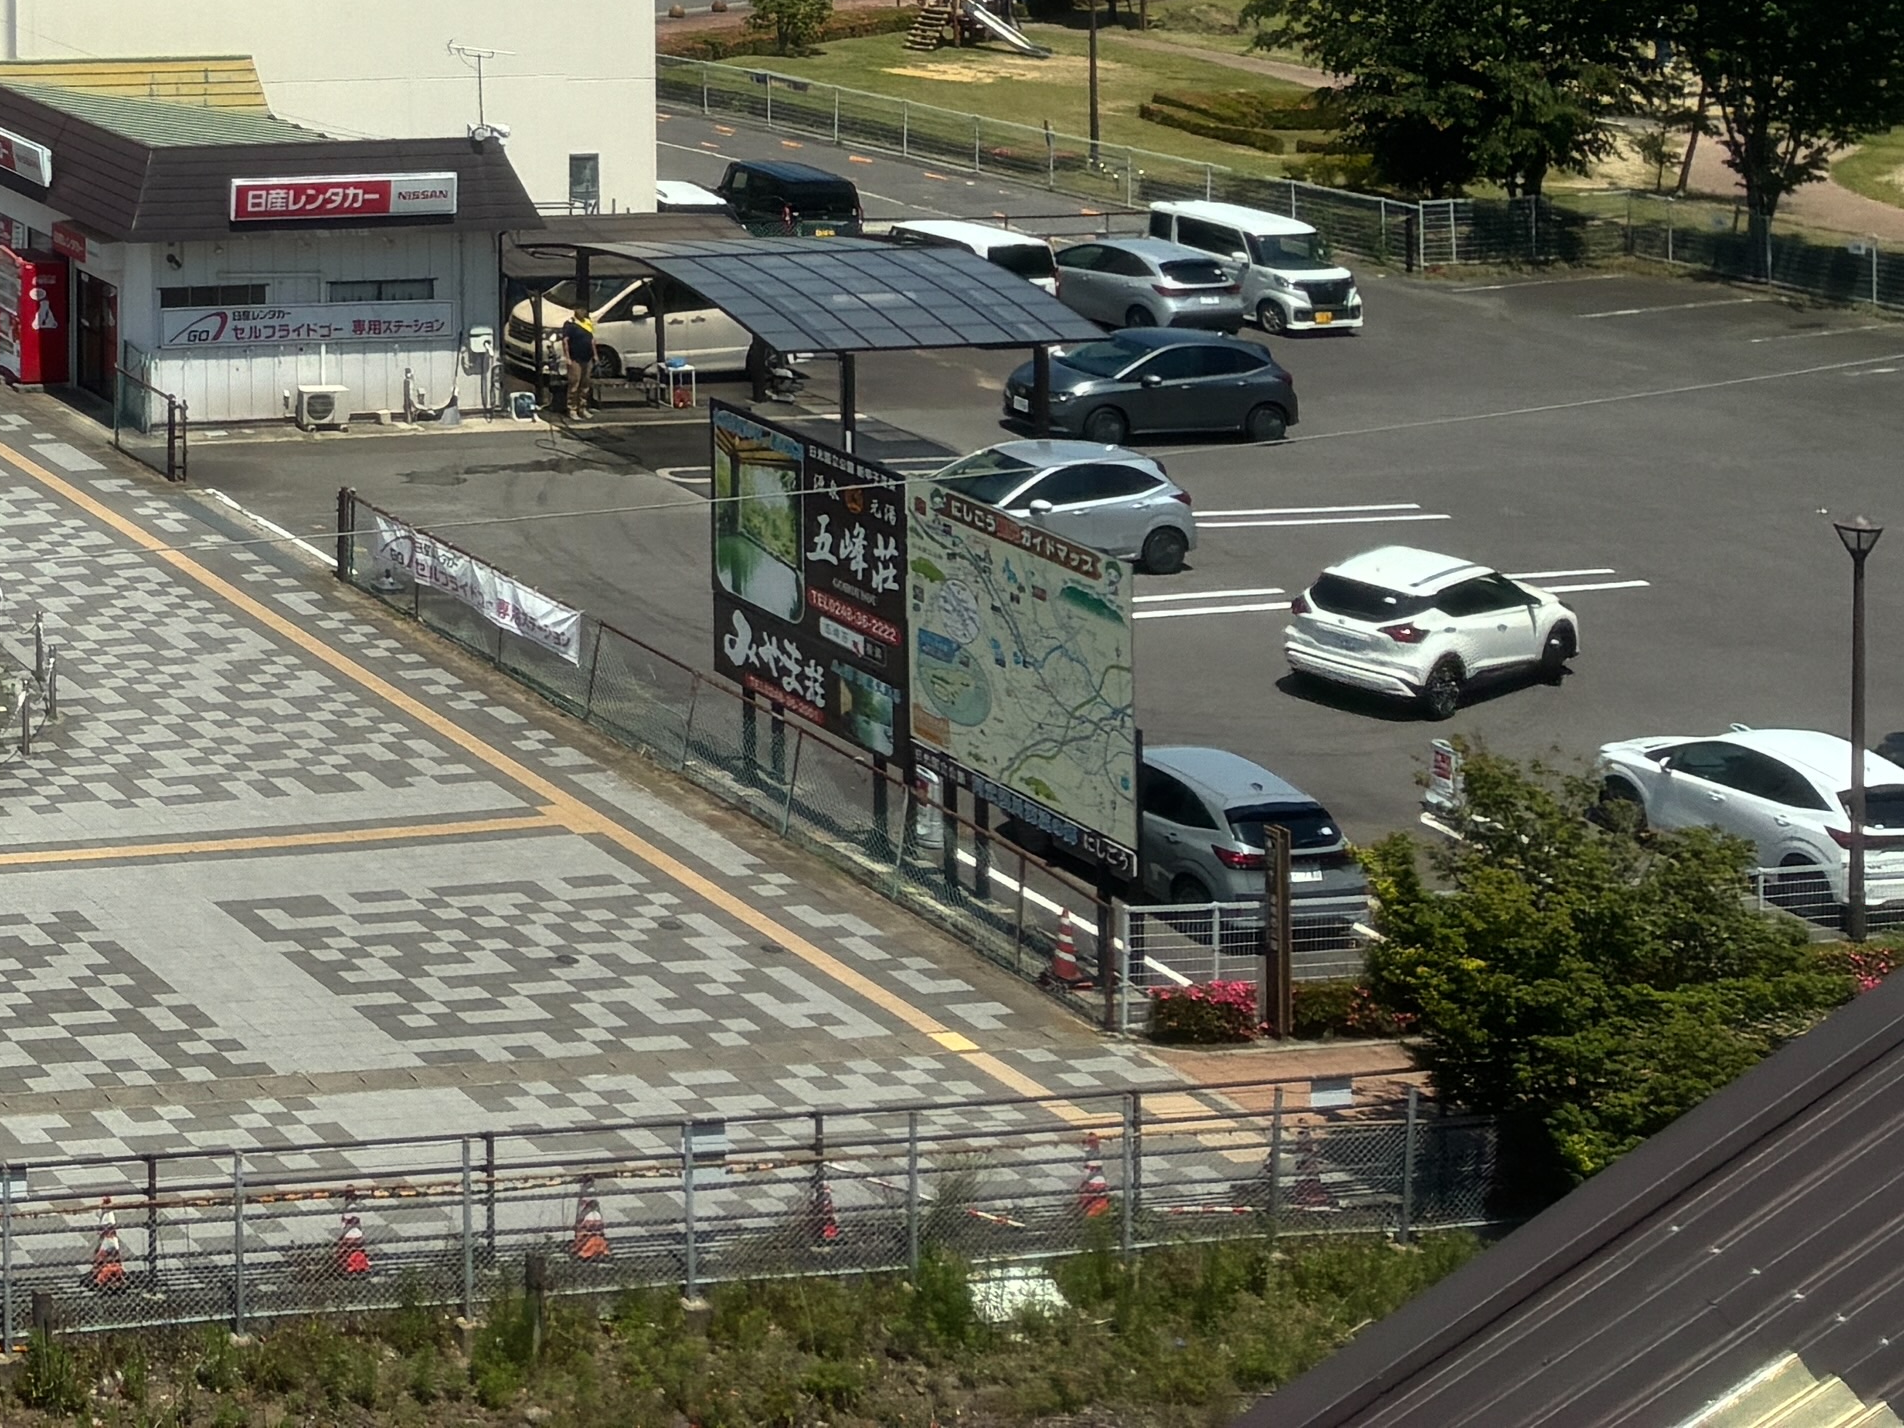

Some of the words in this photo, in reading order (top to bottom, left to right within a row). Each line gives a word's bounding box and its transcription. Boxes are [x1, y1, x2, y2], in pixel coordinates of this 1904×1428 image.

[247, 186, 380, 212] 日産レンタカー
[398, 189, 449, 201] NISSAN
[232, 309, 291, 322] 日産レンタカー
[187, 329, 210, 343] GO
[232, 323, 344, 341] セルフライドゴー
[351, 319, 445, 336] 専用ステーション
[950, 499, 996, 532] にしごう
[1020, 525, 1094, 573] ガイドマップ
[1083, 833, 1129, 872] にしごう
